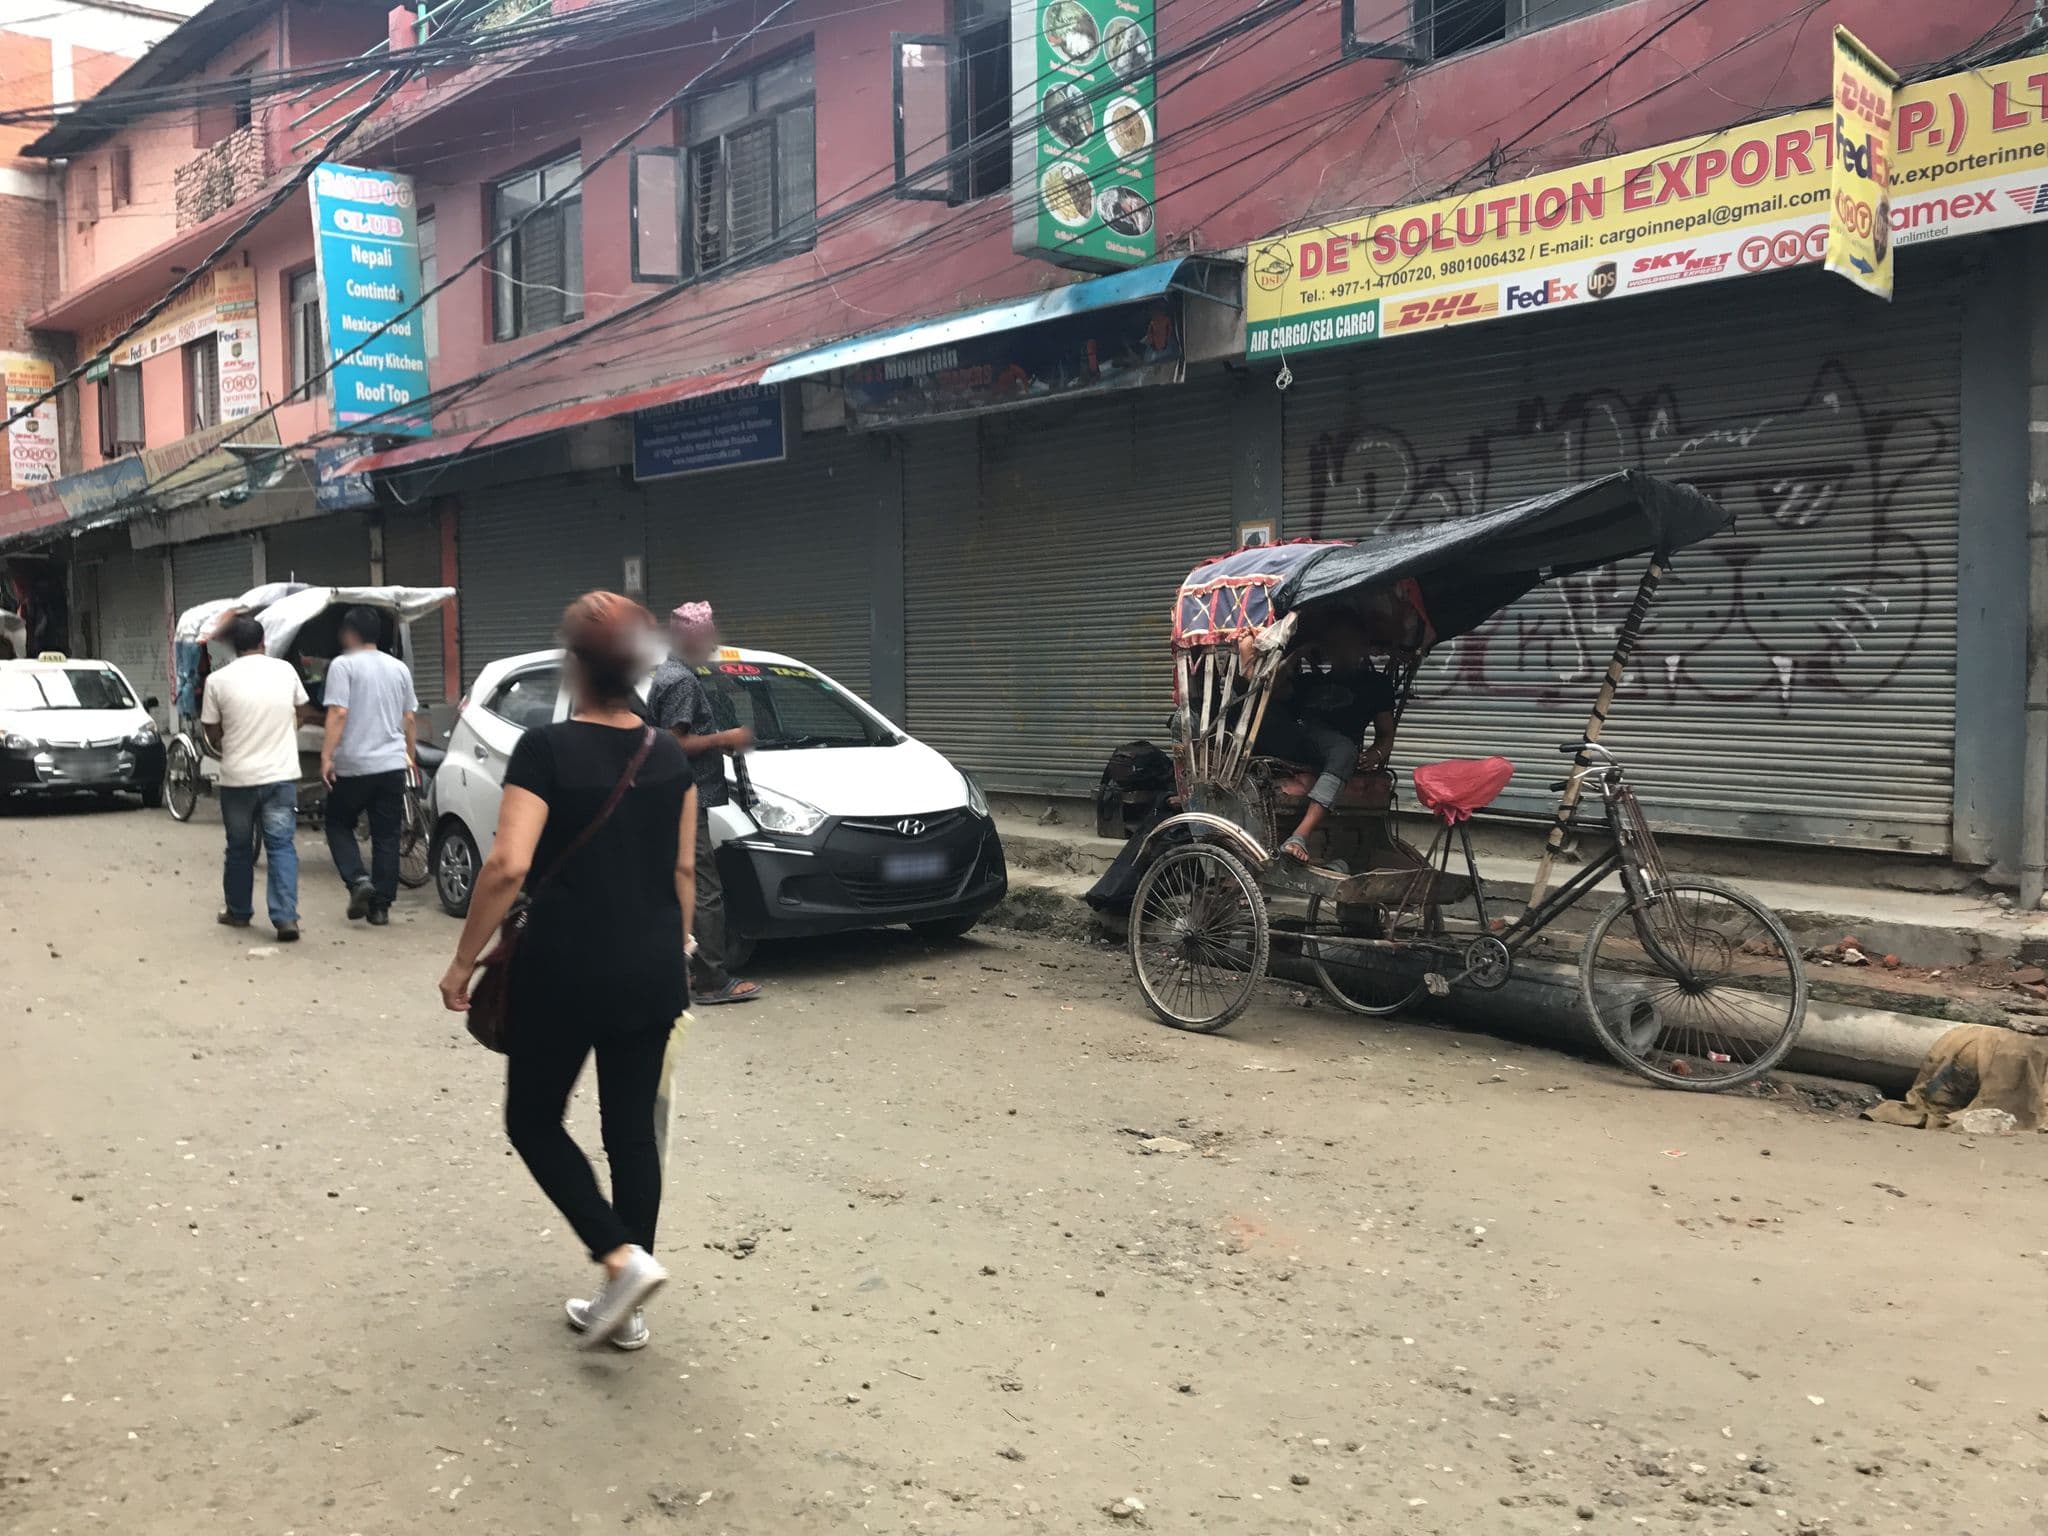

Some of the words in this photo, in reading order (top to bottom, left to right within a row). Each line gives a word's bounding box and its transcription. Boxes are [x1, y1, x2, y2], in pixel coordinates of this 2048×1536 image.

[1841, 72, 1891, 131] DHL
[1371, 176, 1606, 264] SOLUTION
[1622, 122, 1835, 212] EXPORT
[333, 208, 404, 238] CLUB
[1895, 226, 1950, 245] unlimited
[351, 243, 392, 270] Nepali
[1300, 289, 1326, 305] Tel.:
[1329, 266, 1436, 298] +977-1-4700720,
[1440, 245, 1526, 276] 9801006432
[1539, 234, 1594, 259] E-mail:
[1599, 188, 1832, 247] cargoinnepal@gmail.com
[1506, 276, 1579, 310] FedEx
[1586, 269, 1617, 298] ups
[1398, 291, 1482, 328] DHL
[219, 328, 252, 343] FedEx
[1250, 329, 1269, 353] AIR
[1270, 317, 1334, 350] CARGO/SEA
[1335, 309, 1376, 340] CARGO
[355, 351, 384, 372] Curry
[385, 352, 423, 372] Kitchen
[355, 380, 385, 402] Roof
[386, 382, 411, 405] Top
